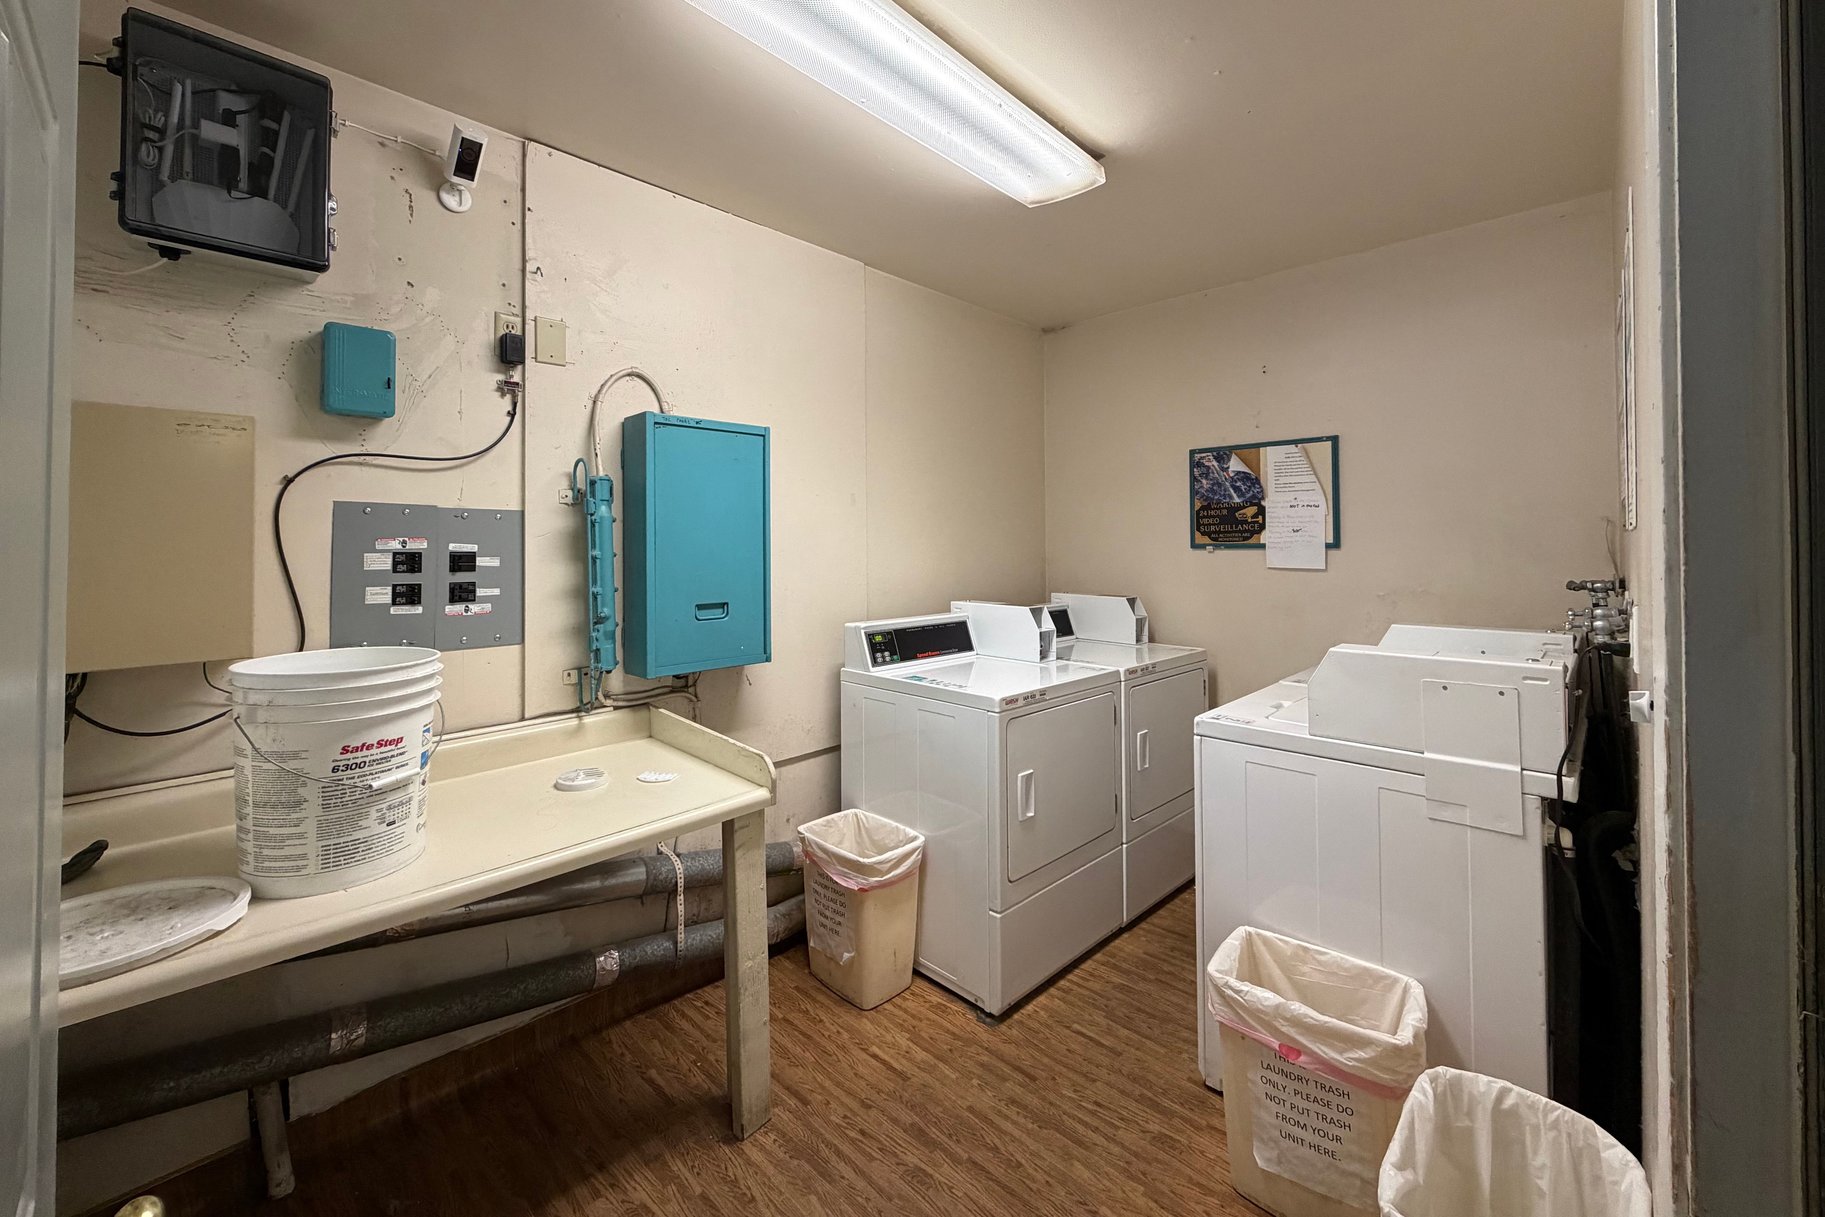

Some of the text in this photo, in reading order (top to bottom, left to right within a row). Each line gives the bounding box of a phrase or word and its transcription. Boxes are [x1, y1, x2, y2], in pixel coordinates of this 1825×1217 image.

[1200, 523, 1260, 532] SURVEILLANCE
[331, 760, 367, 774] 6300
[1260, 1060, 1351, 1101] LAUNDRY TRASH
[1260, 1074, 1354, 1117] ONLY. PLEASE DO
[1264, 1091, 1352, 1132] NOT PUT TRASH
[1275, 1111, 1344, 1145] FROM YOUR
[1279, 1128, 1342, 1162] UNIT HERE.
